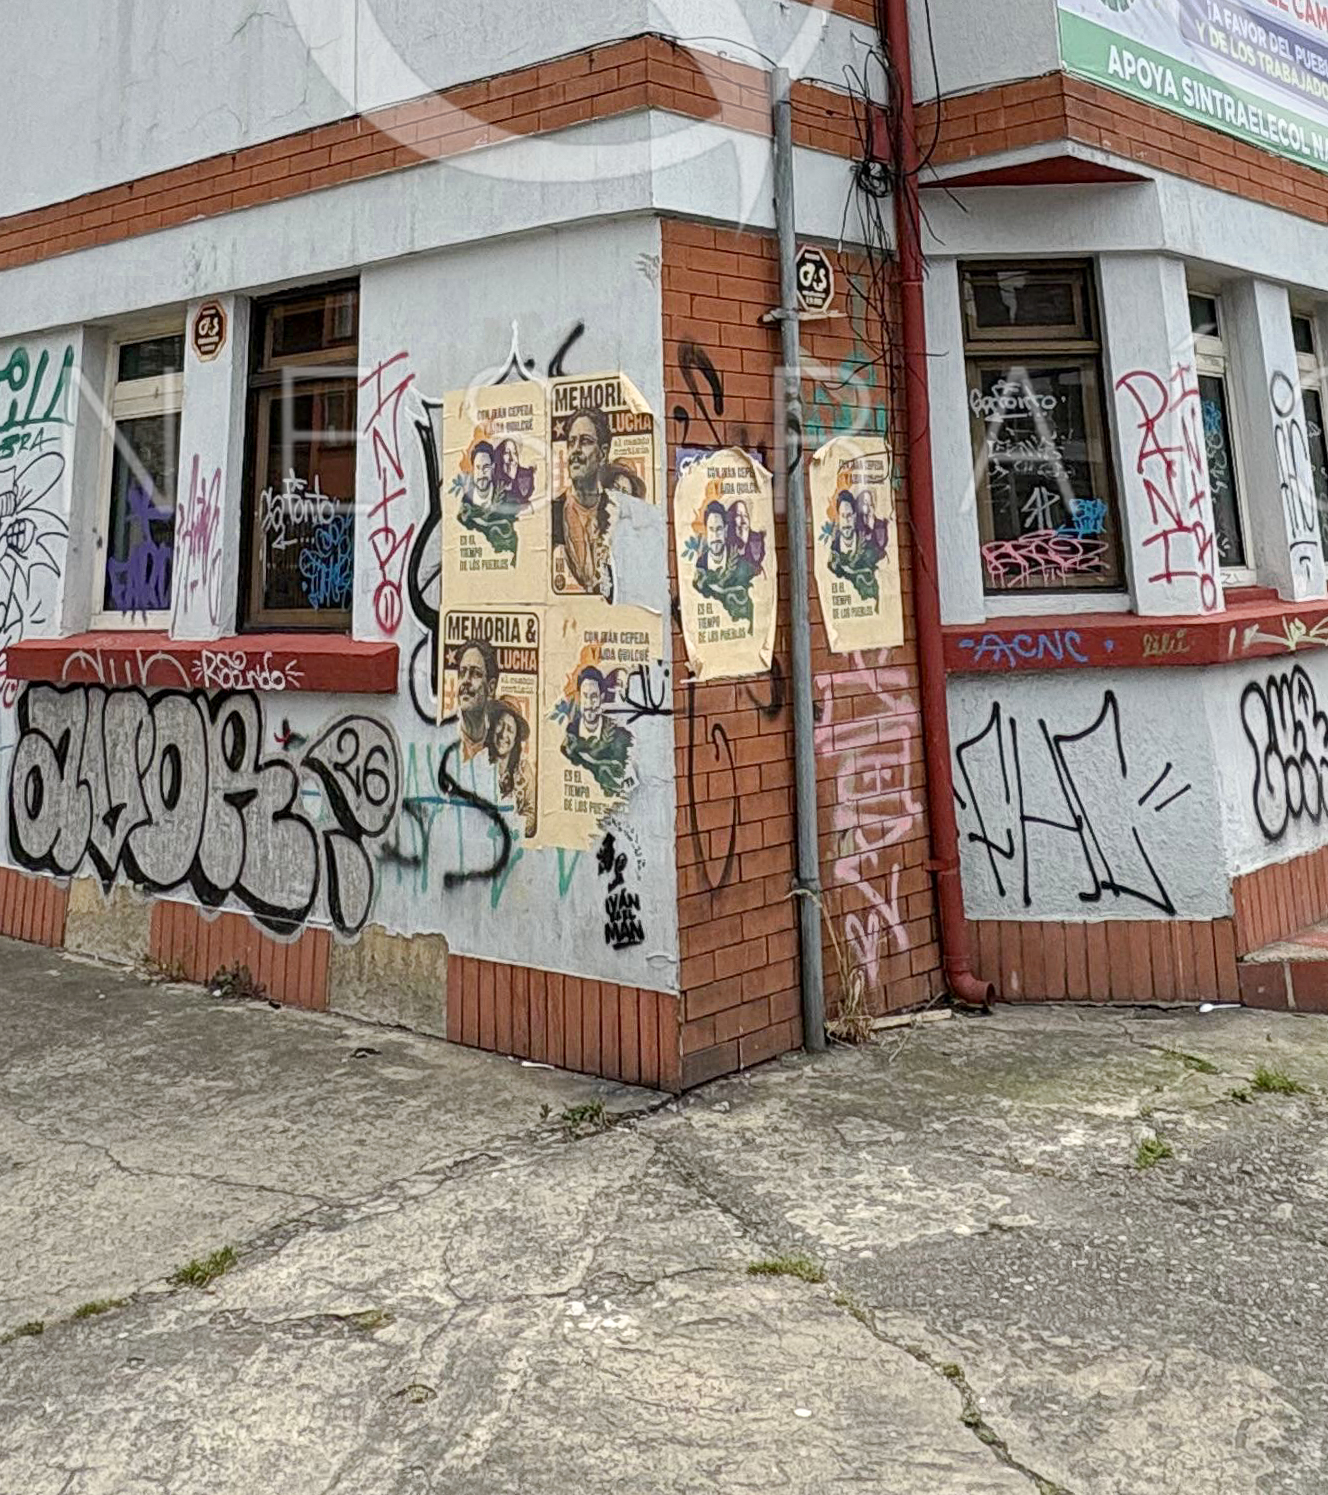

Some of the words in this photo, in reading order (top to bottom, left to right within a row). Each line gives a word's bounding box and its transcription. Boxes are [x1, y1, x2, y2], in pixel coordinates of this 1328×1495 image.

[1223, 3, 1268, 44] FAVOR
[1269, 31, 1293, 56] DEL
[1195, 20, 1207, 43] Y
[1209, 26, 1229, 52] DE
[1230, 39, 1256, 67] LOS
[1107, 44, 1181, 103] APOYA
[1181, 75, 1312, 155] SINTRAELECOL
[555, 379, 627, 412] MEMORI
[610, 416, 652, 434] LUCHA
[447, 615, 521, 643] MEMORIA
[525, 618, 537, 643] &
[698, 616, 720, 628] TIEMPO
[620, 631, 650, 644] CEPEDA
[720, 627, 746, 641] PUEBLOS
[496, 649, 537, 672] LUCHA
[564, 784, 590, 798] TIEMPO
[564, 798, 573, 811] DE
[575, 799, 588, 813] LOS
